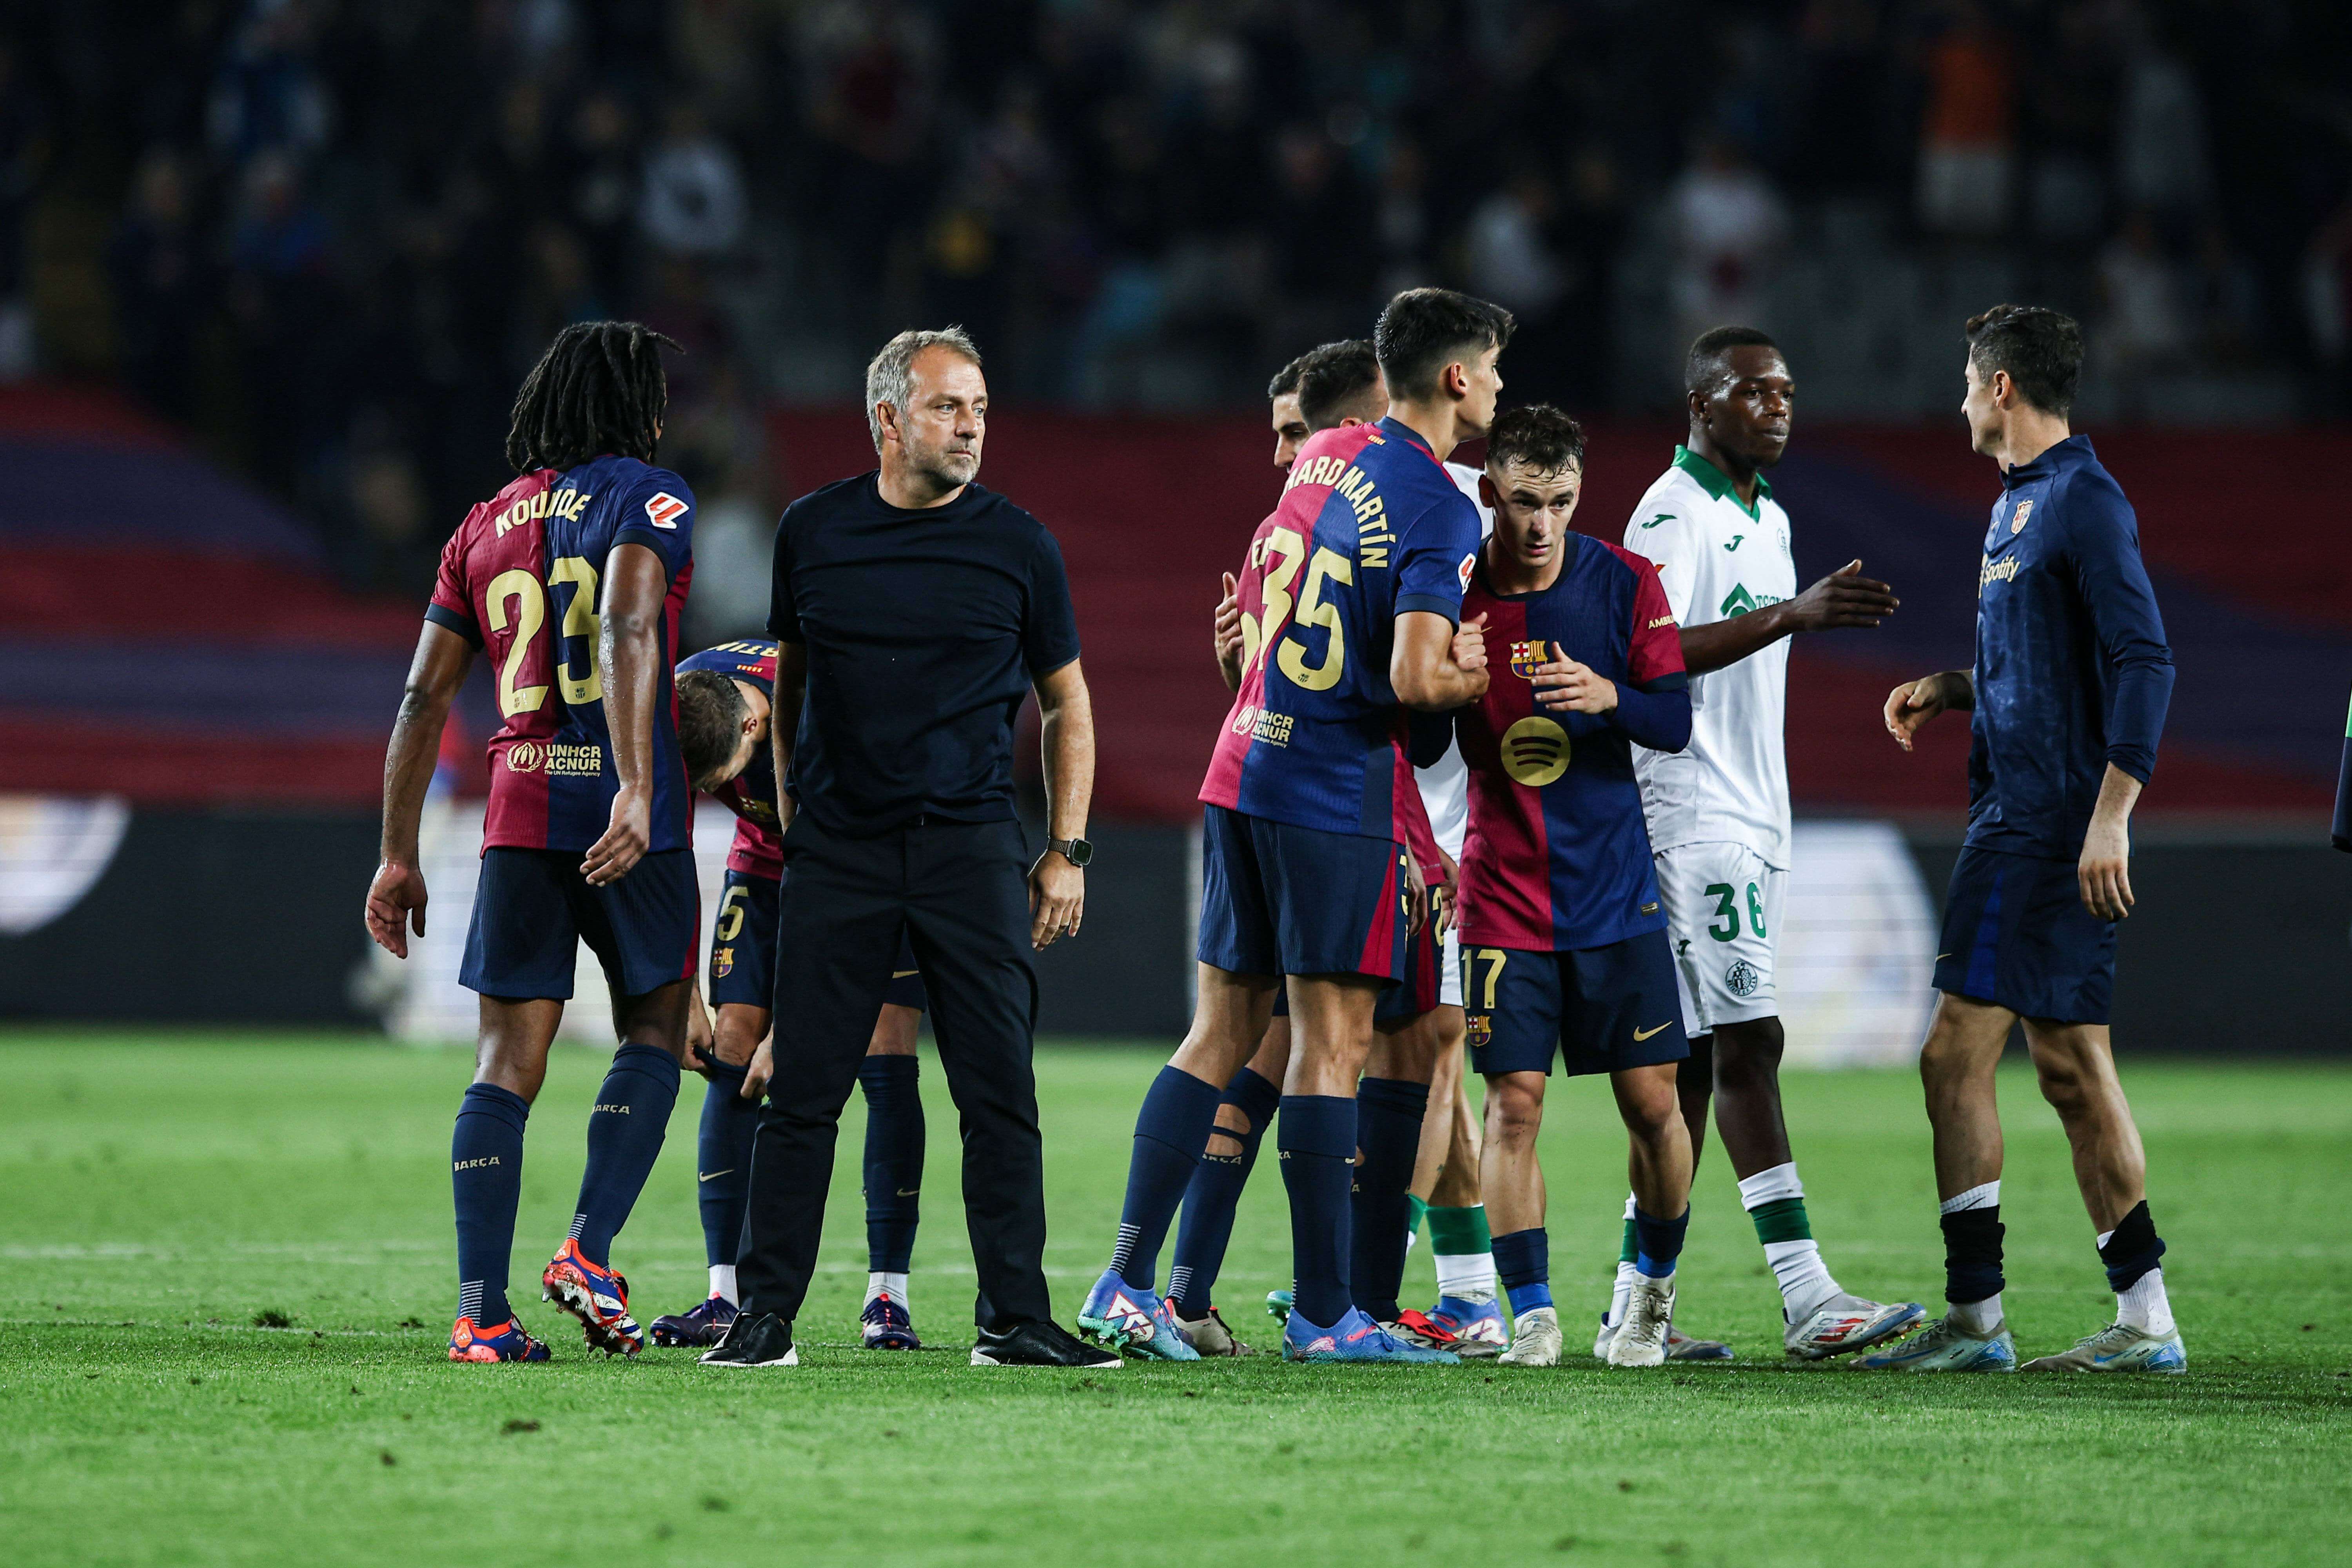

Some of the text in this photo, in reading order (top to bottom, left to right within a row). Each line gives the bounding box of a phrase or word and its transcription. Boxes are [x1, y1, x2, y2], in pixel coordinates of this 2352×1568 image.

[1334, 466, 1396, 568] MARTÍN
[1984, 555, 2020, 587] Spotify
[1258, 526, 1353, 691] 35
[486, 556, 603, 719] 23
[546, 744, 601, 758] UNHCR
[1251, 722, 1290, 742] ACNUR
[544, 757, 601, 771] ACNUR
[717, 886, 749, 941] 5
[1704, 882, 1766, 942] 36
[1461, 949, 1506, 1009] 17
[454, 1156, 500, 1172] BARÇA
